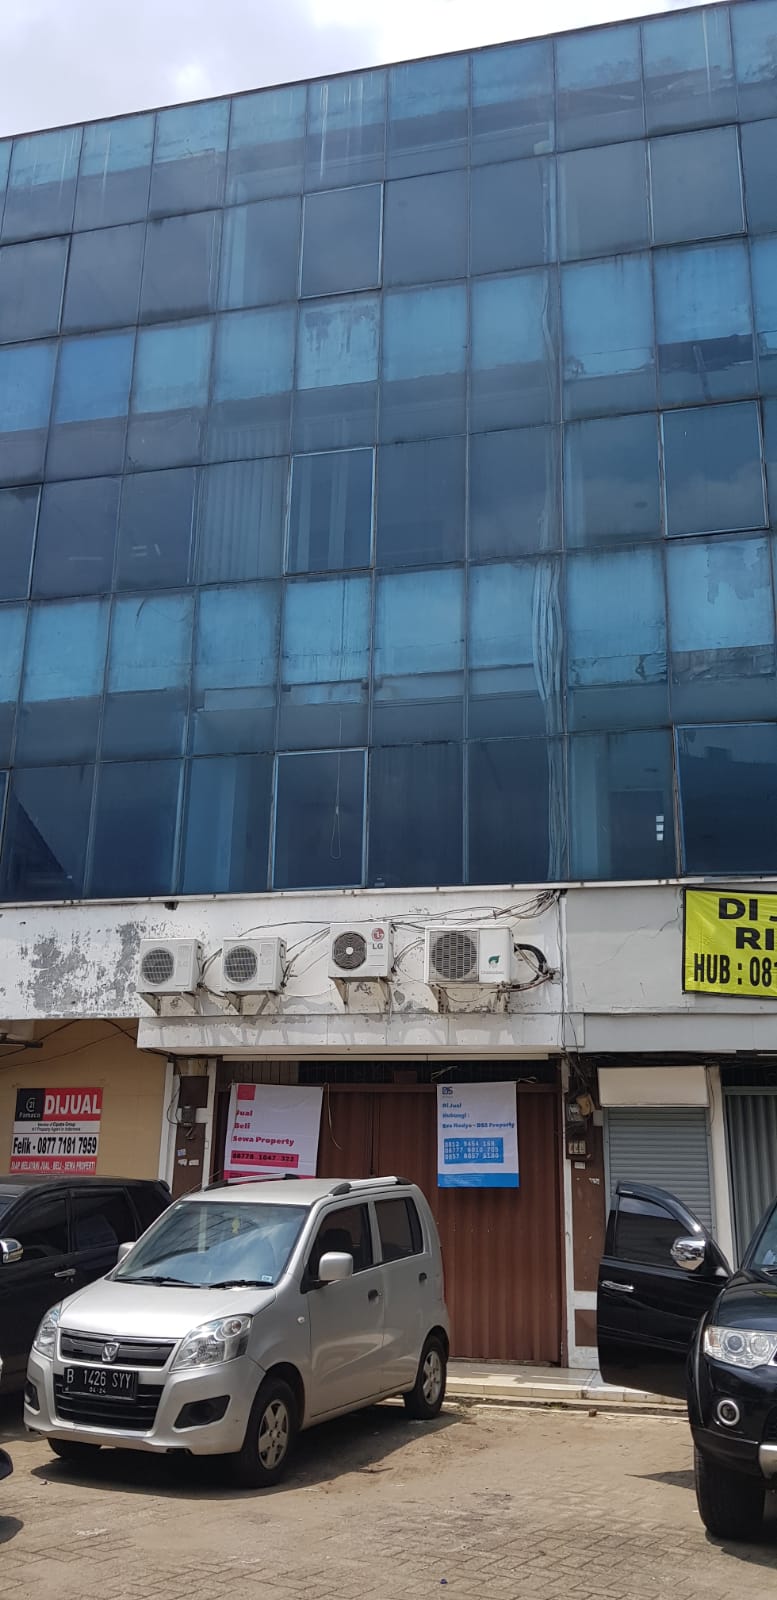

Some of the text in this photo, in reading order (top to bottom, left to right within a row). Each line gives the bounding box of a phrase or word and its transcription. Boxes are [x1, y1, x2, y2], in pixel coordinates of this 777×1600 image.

[719, 898, 758, 920] DI
[694, 953, 730, 984] HUB
[44, 1094, 101, 1115] DIJUAL
[13, 1137, 31, 1154] Felik
[37, 1137, 56, 1154] 0877
[57, 1137, 76, 1154] 7181
[78, 1137, 97, 1154] 7959
[255, 1136, 295, 1147] Property
[66, 1368, 131, 1389] B 1426 SYY
